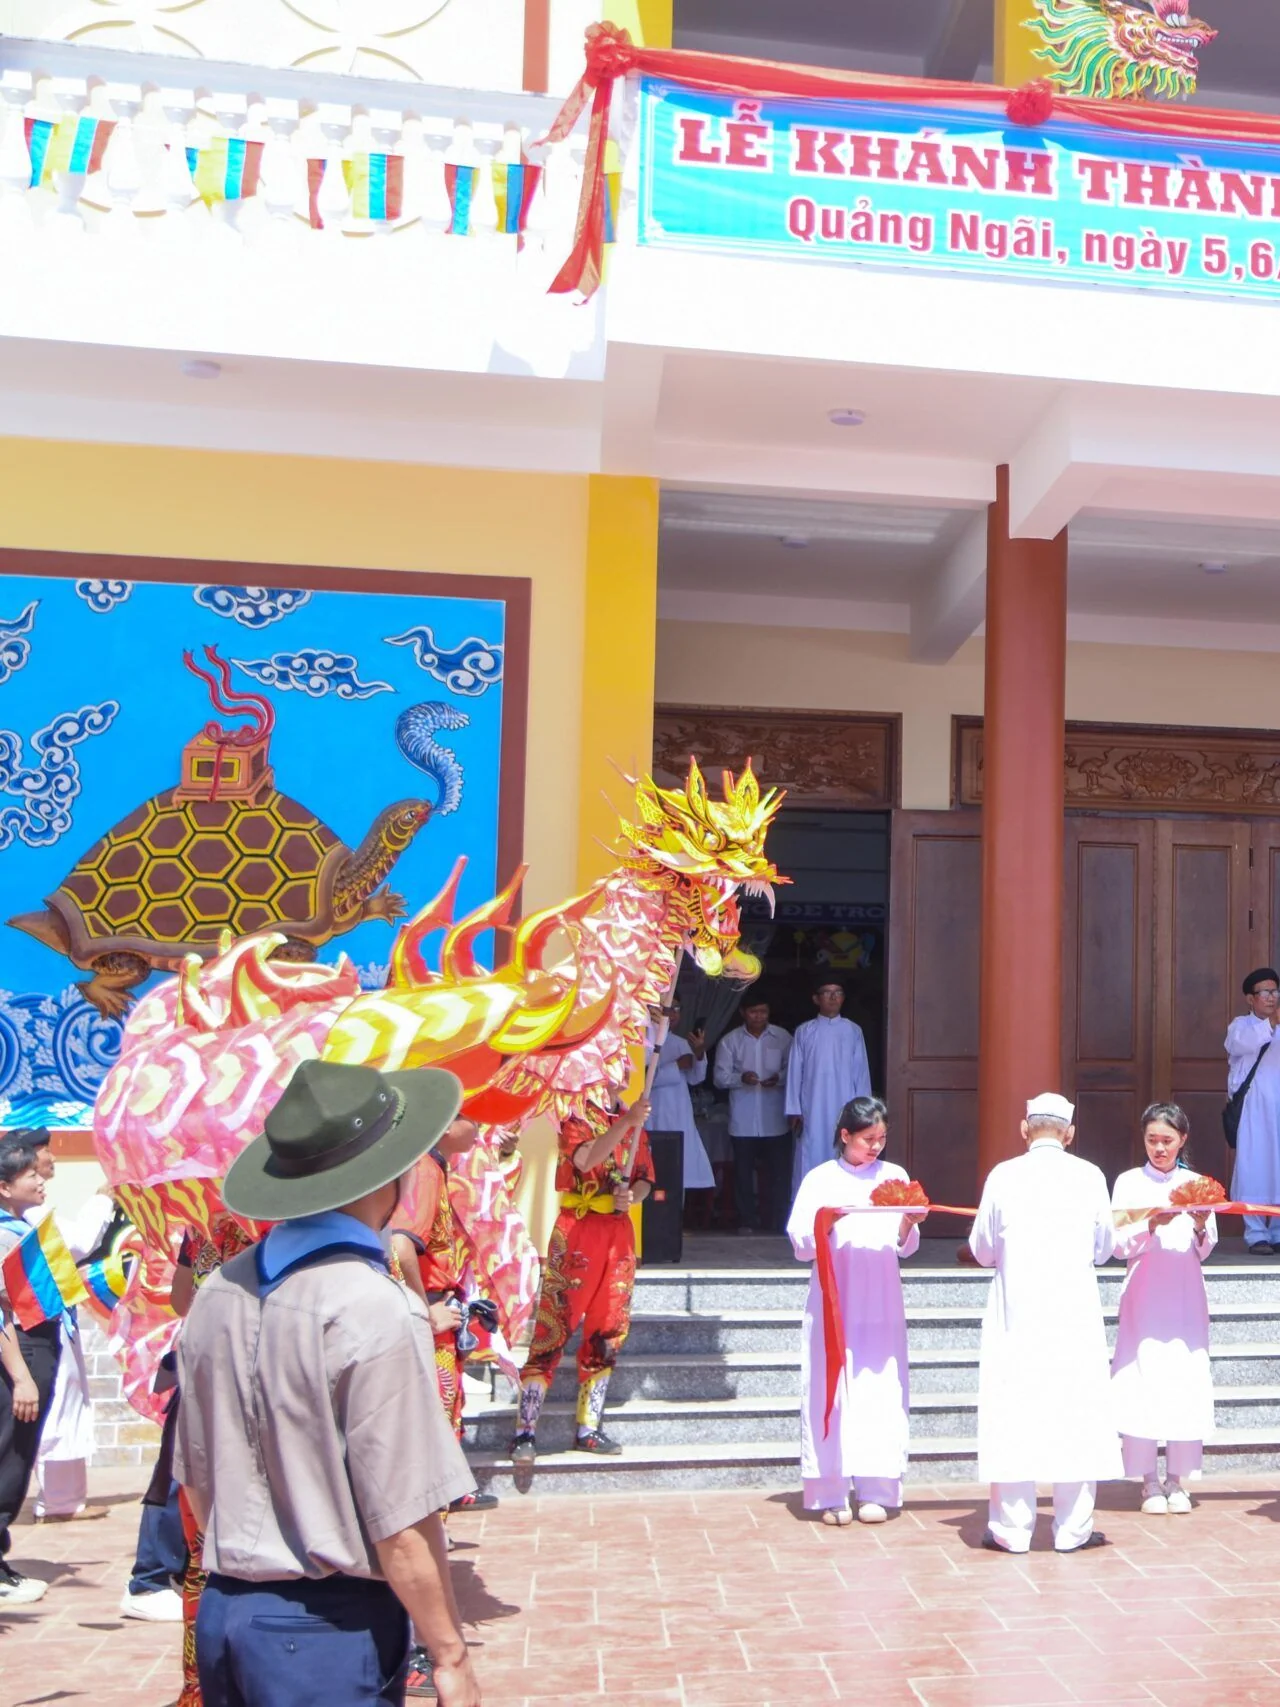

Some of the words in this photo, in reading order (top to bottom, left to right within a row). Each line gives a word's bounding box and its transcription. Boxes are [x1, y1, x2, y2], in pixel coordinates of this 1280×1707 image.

[679, 103, 768, 168] LỄ
[795, 129, 1053, 195] KHÁNH
[789, 199, 932, 252] Quảng
[950, 213, 1068, 265] Ngãi,
[1084, 231, 1188, 275] ngày
